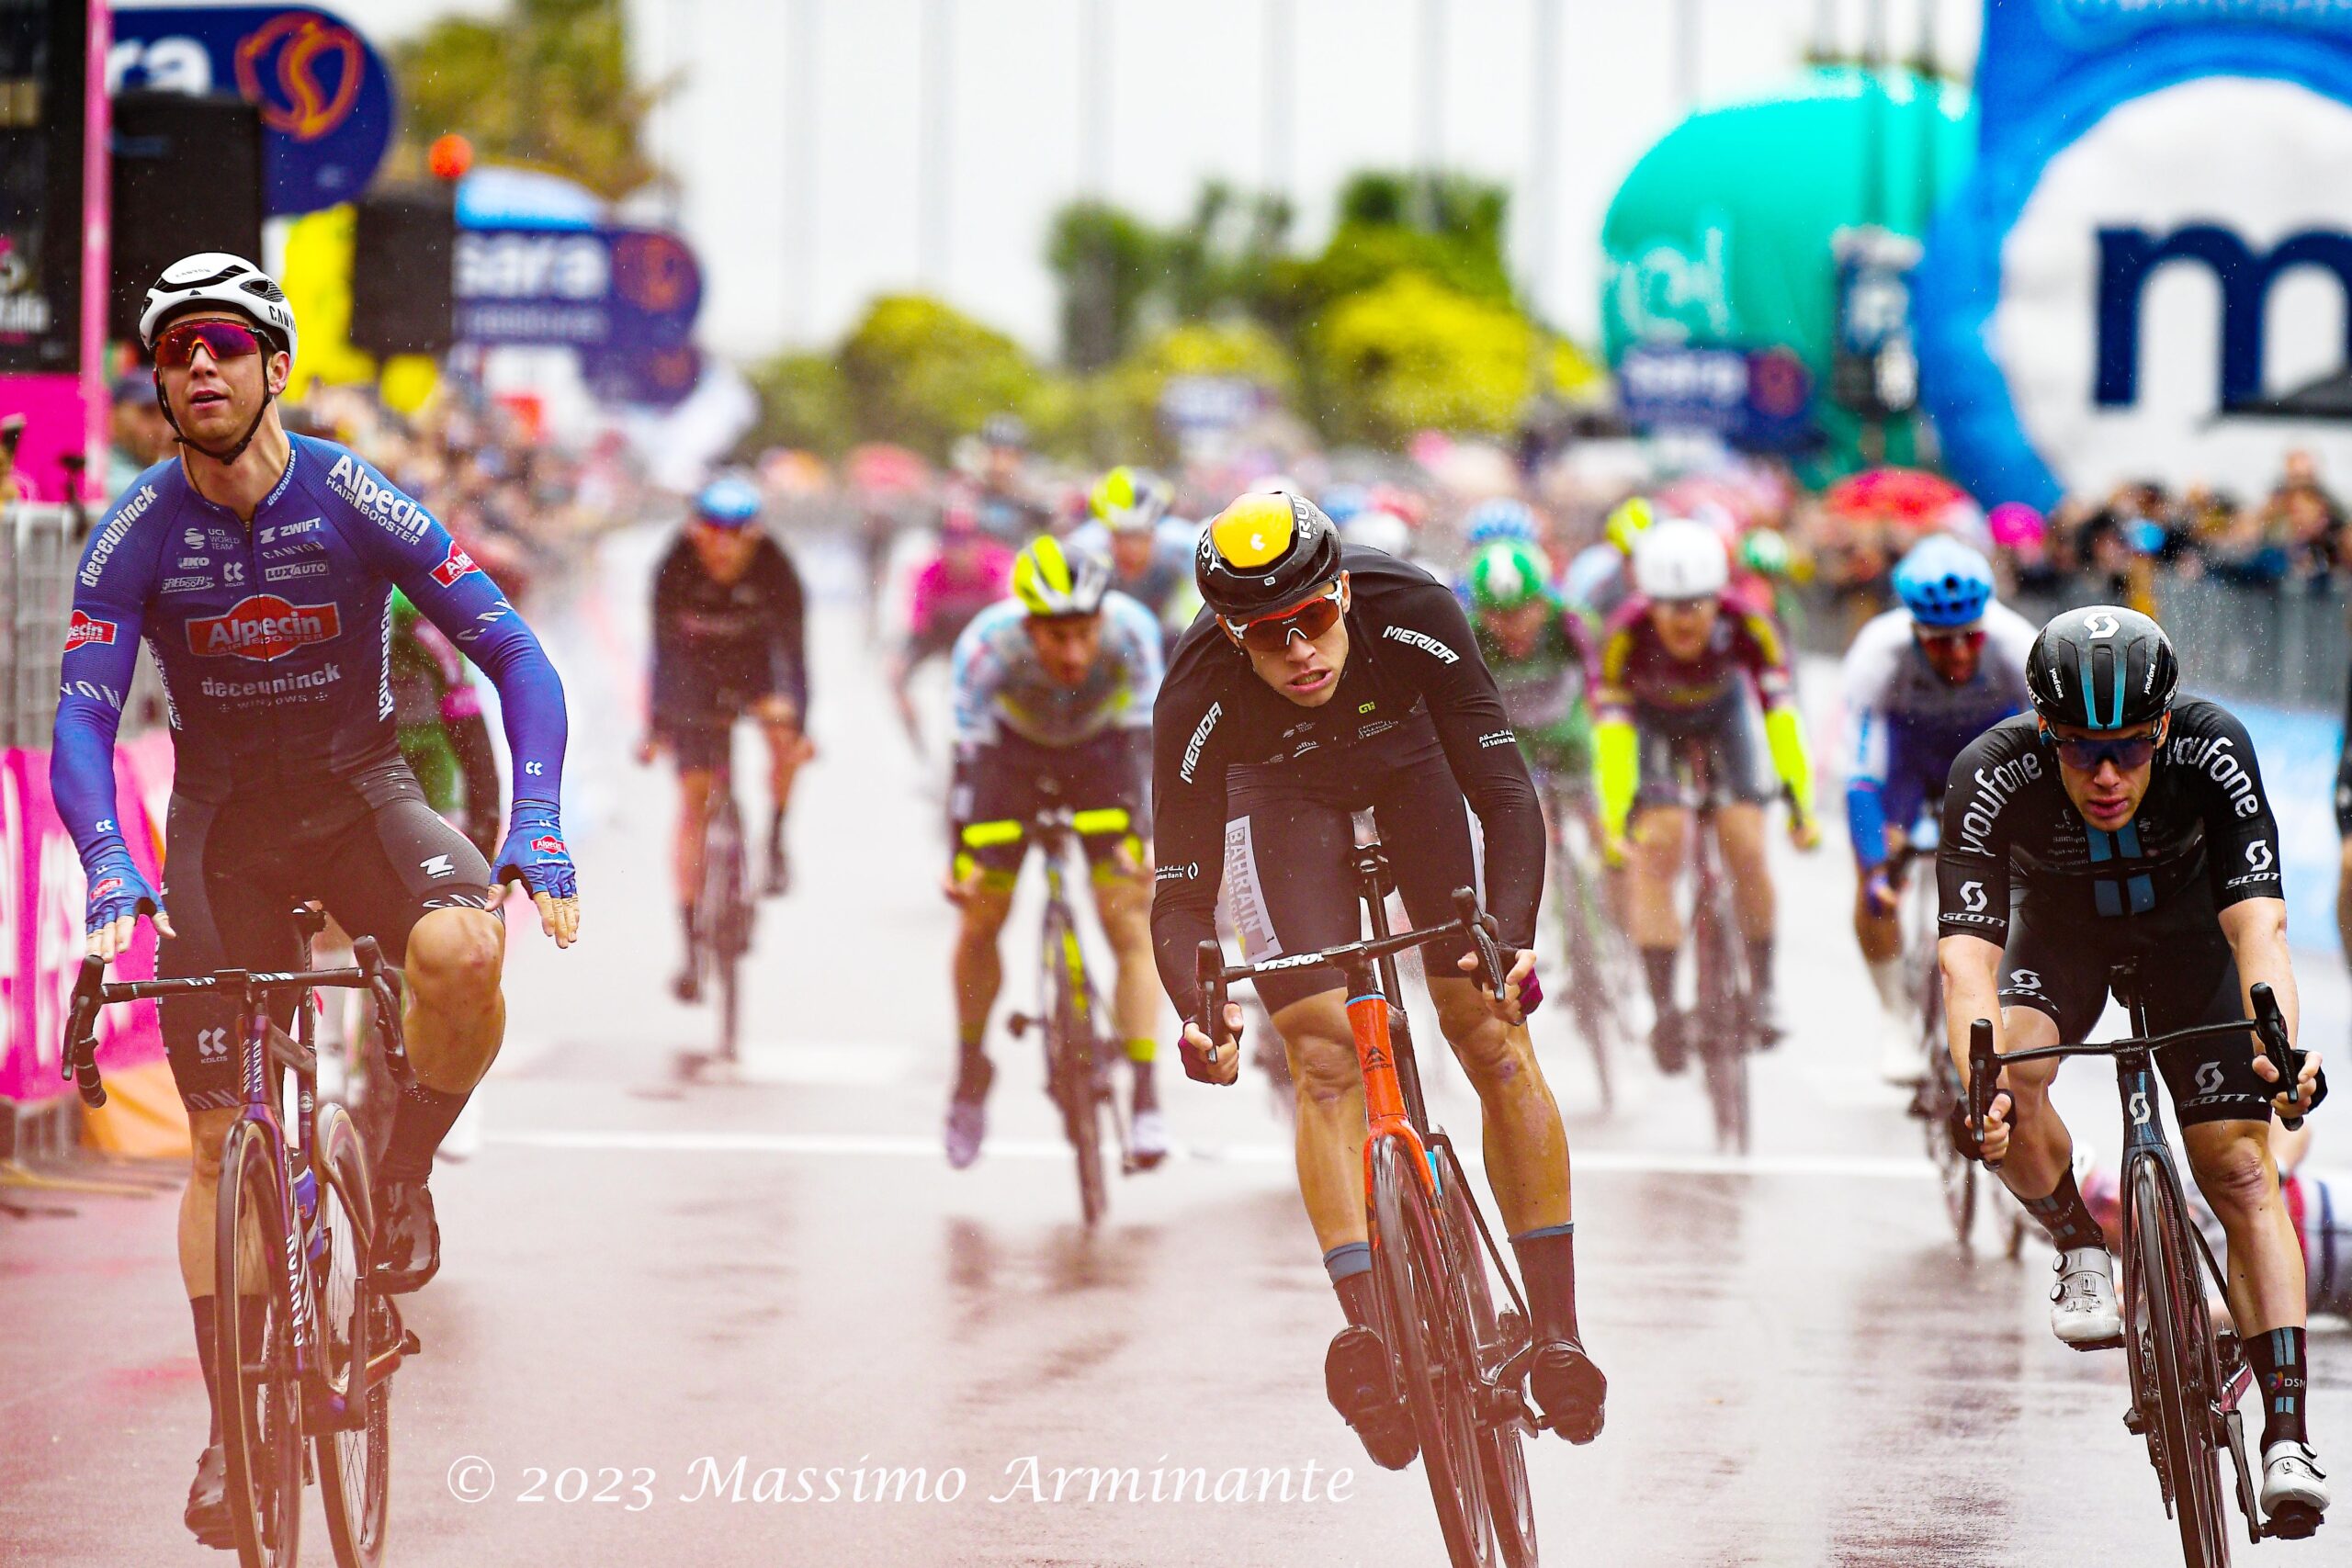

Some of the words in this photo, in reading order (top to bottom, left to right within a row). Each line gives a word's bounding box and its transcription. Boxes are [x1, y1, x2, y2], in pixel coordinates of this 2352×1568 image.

[267, 449, 296, 506] deceuninck
[328, 455, 431, 537] Alpecin
[280, 517, 321, 536] ZWIFT
[326, 477, 356, 504] HAIR
[360, 505, 420, 546] BOOSTER
[79, 484, 158, 588] deceuninck
[209, 536, 240, 544] WORLD
[262, 541, 324, 559] CANYON
[207, 611, 322, 648] Alpecin
[1382, 625, 1460, 665] MERIDA
[201, 662, 341, 697] deceuninck
[1180, 701, 1223, 784] MERIDA
[1960, 752, 2042, 857] youfone
[1227, 827, 1261, 933] BAHRAIN
[1942, 912, 2007, 928] SCOTT
[2115, 1045, 2144, 1054] wahoo
[2182, 1094, 2250, 1110] SCOTT
[2284, 1378, 2305, 1389] DSM
